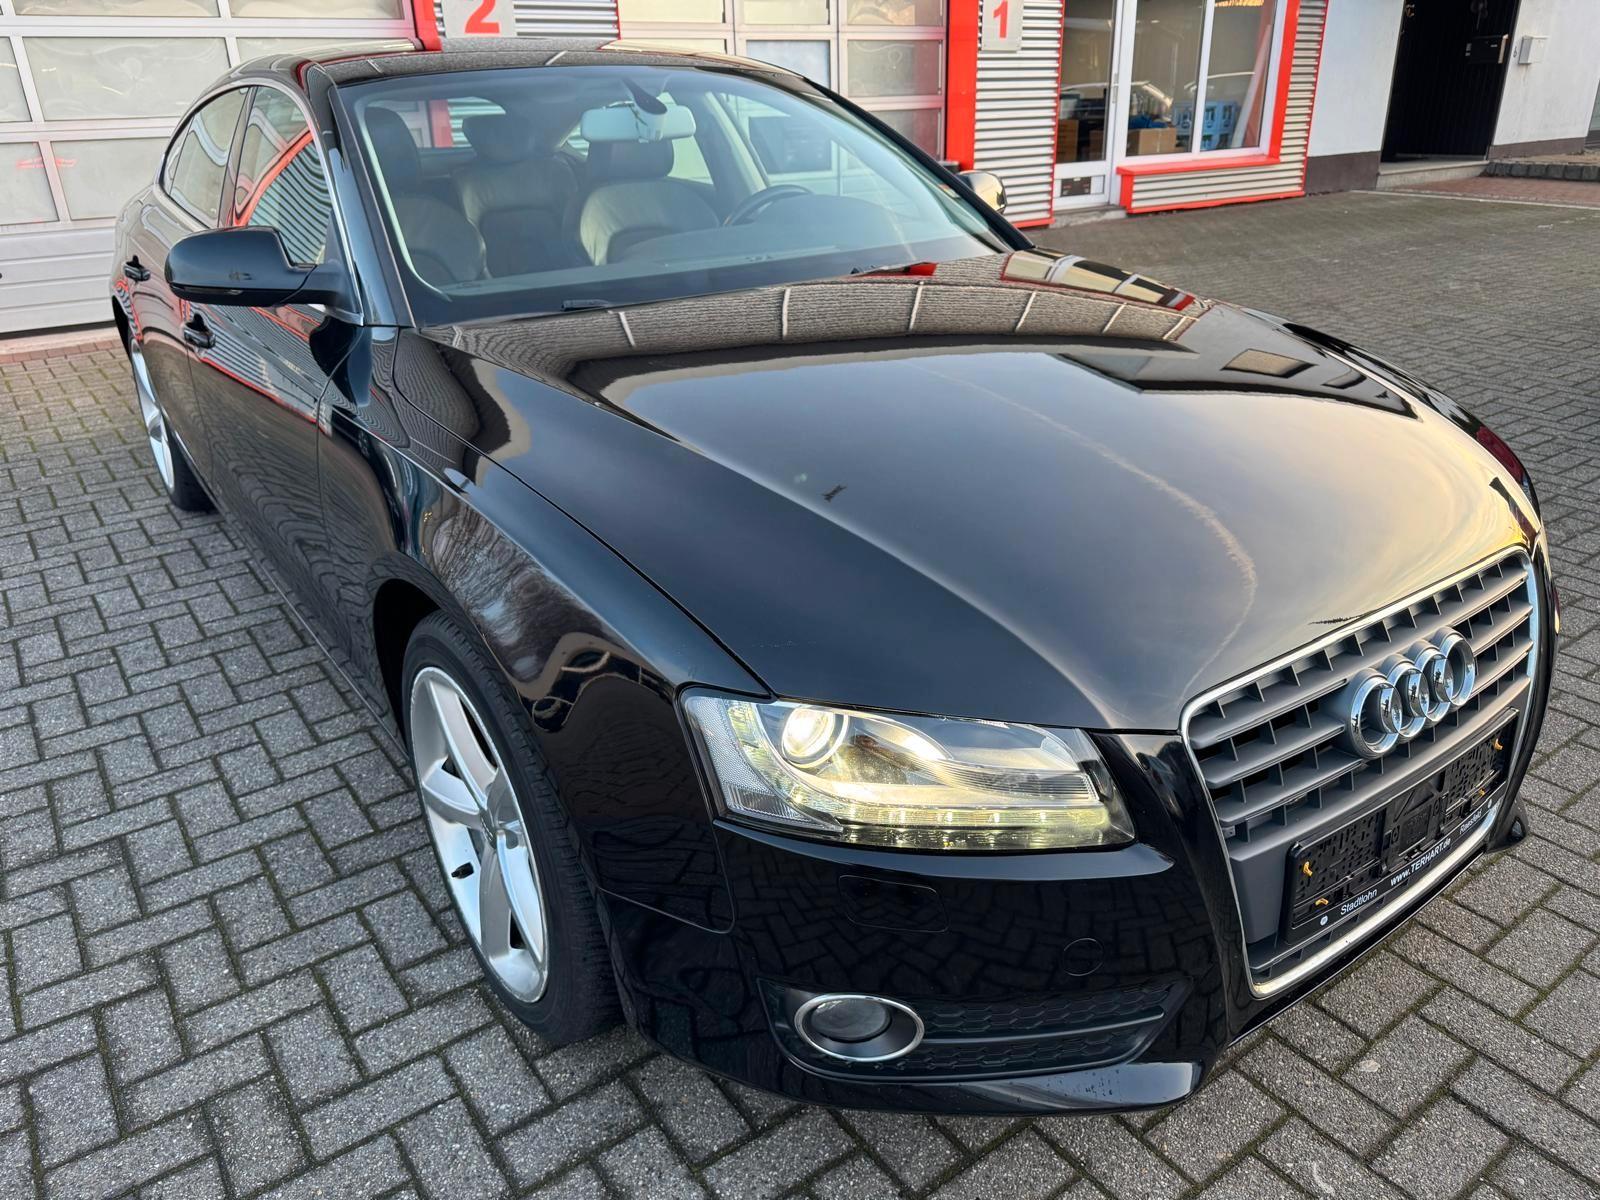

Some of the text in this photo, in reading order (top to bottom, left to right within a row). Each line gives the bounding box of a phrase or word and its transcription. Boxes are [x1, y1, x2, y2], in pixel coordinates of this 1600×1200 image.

[464, 0, 500, 34] 2
[993, 0, 1008, 38] 1
[1340, 889, 1378, 916] Stadtlohn
